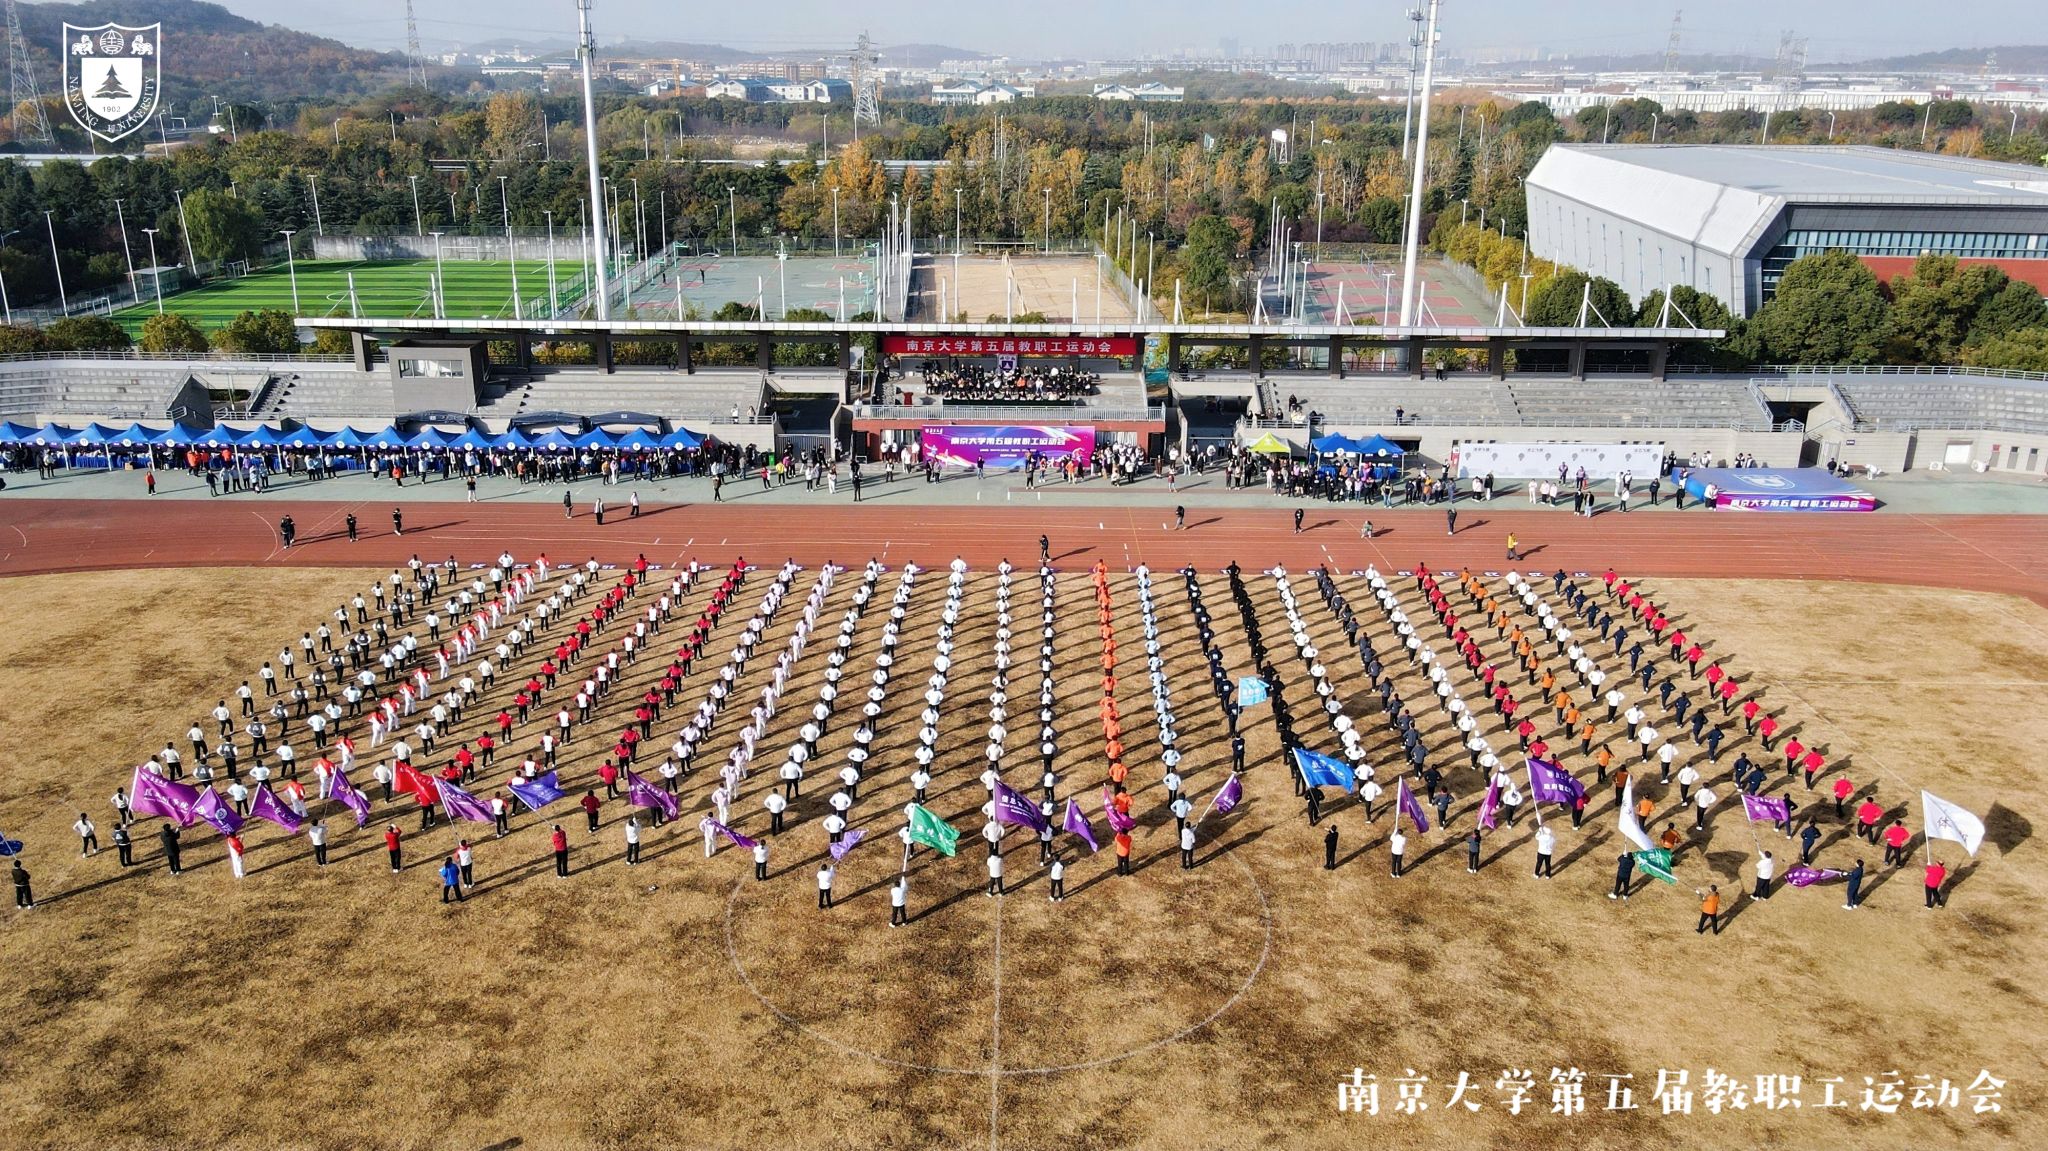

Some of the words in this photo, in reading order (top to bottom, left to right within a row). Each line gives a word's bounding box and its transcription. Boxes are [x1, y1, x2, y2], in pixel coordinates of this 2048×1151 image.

[906, 339, 1112, 353] 南京大学第五届教职工运动会
